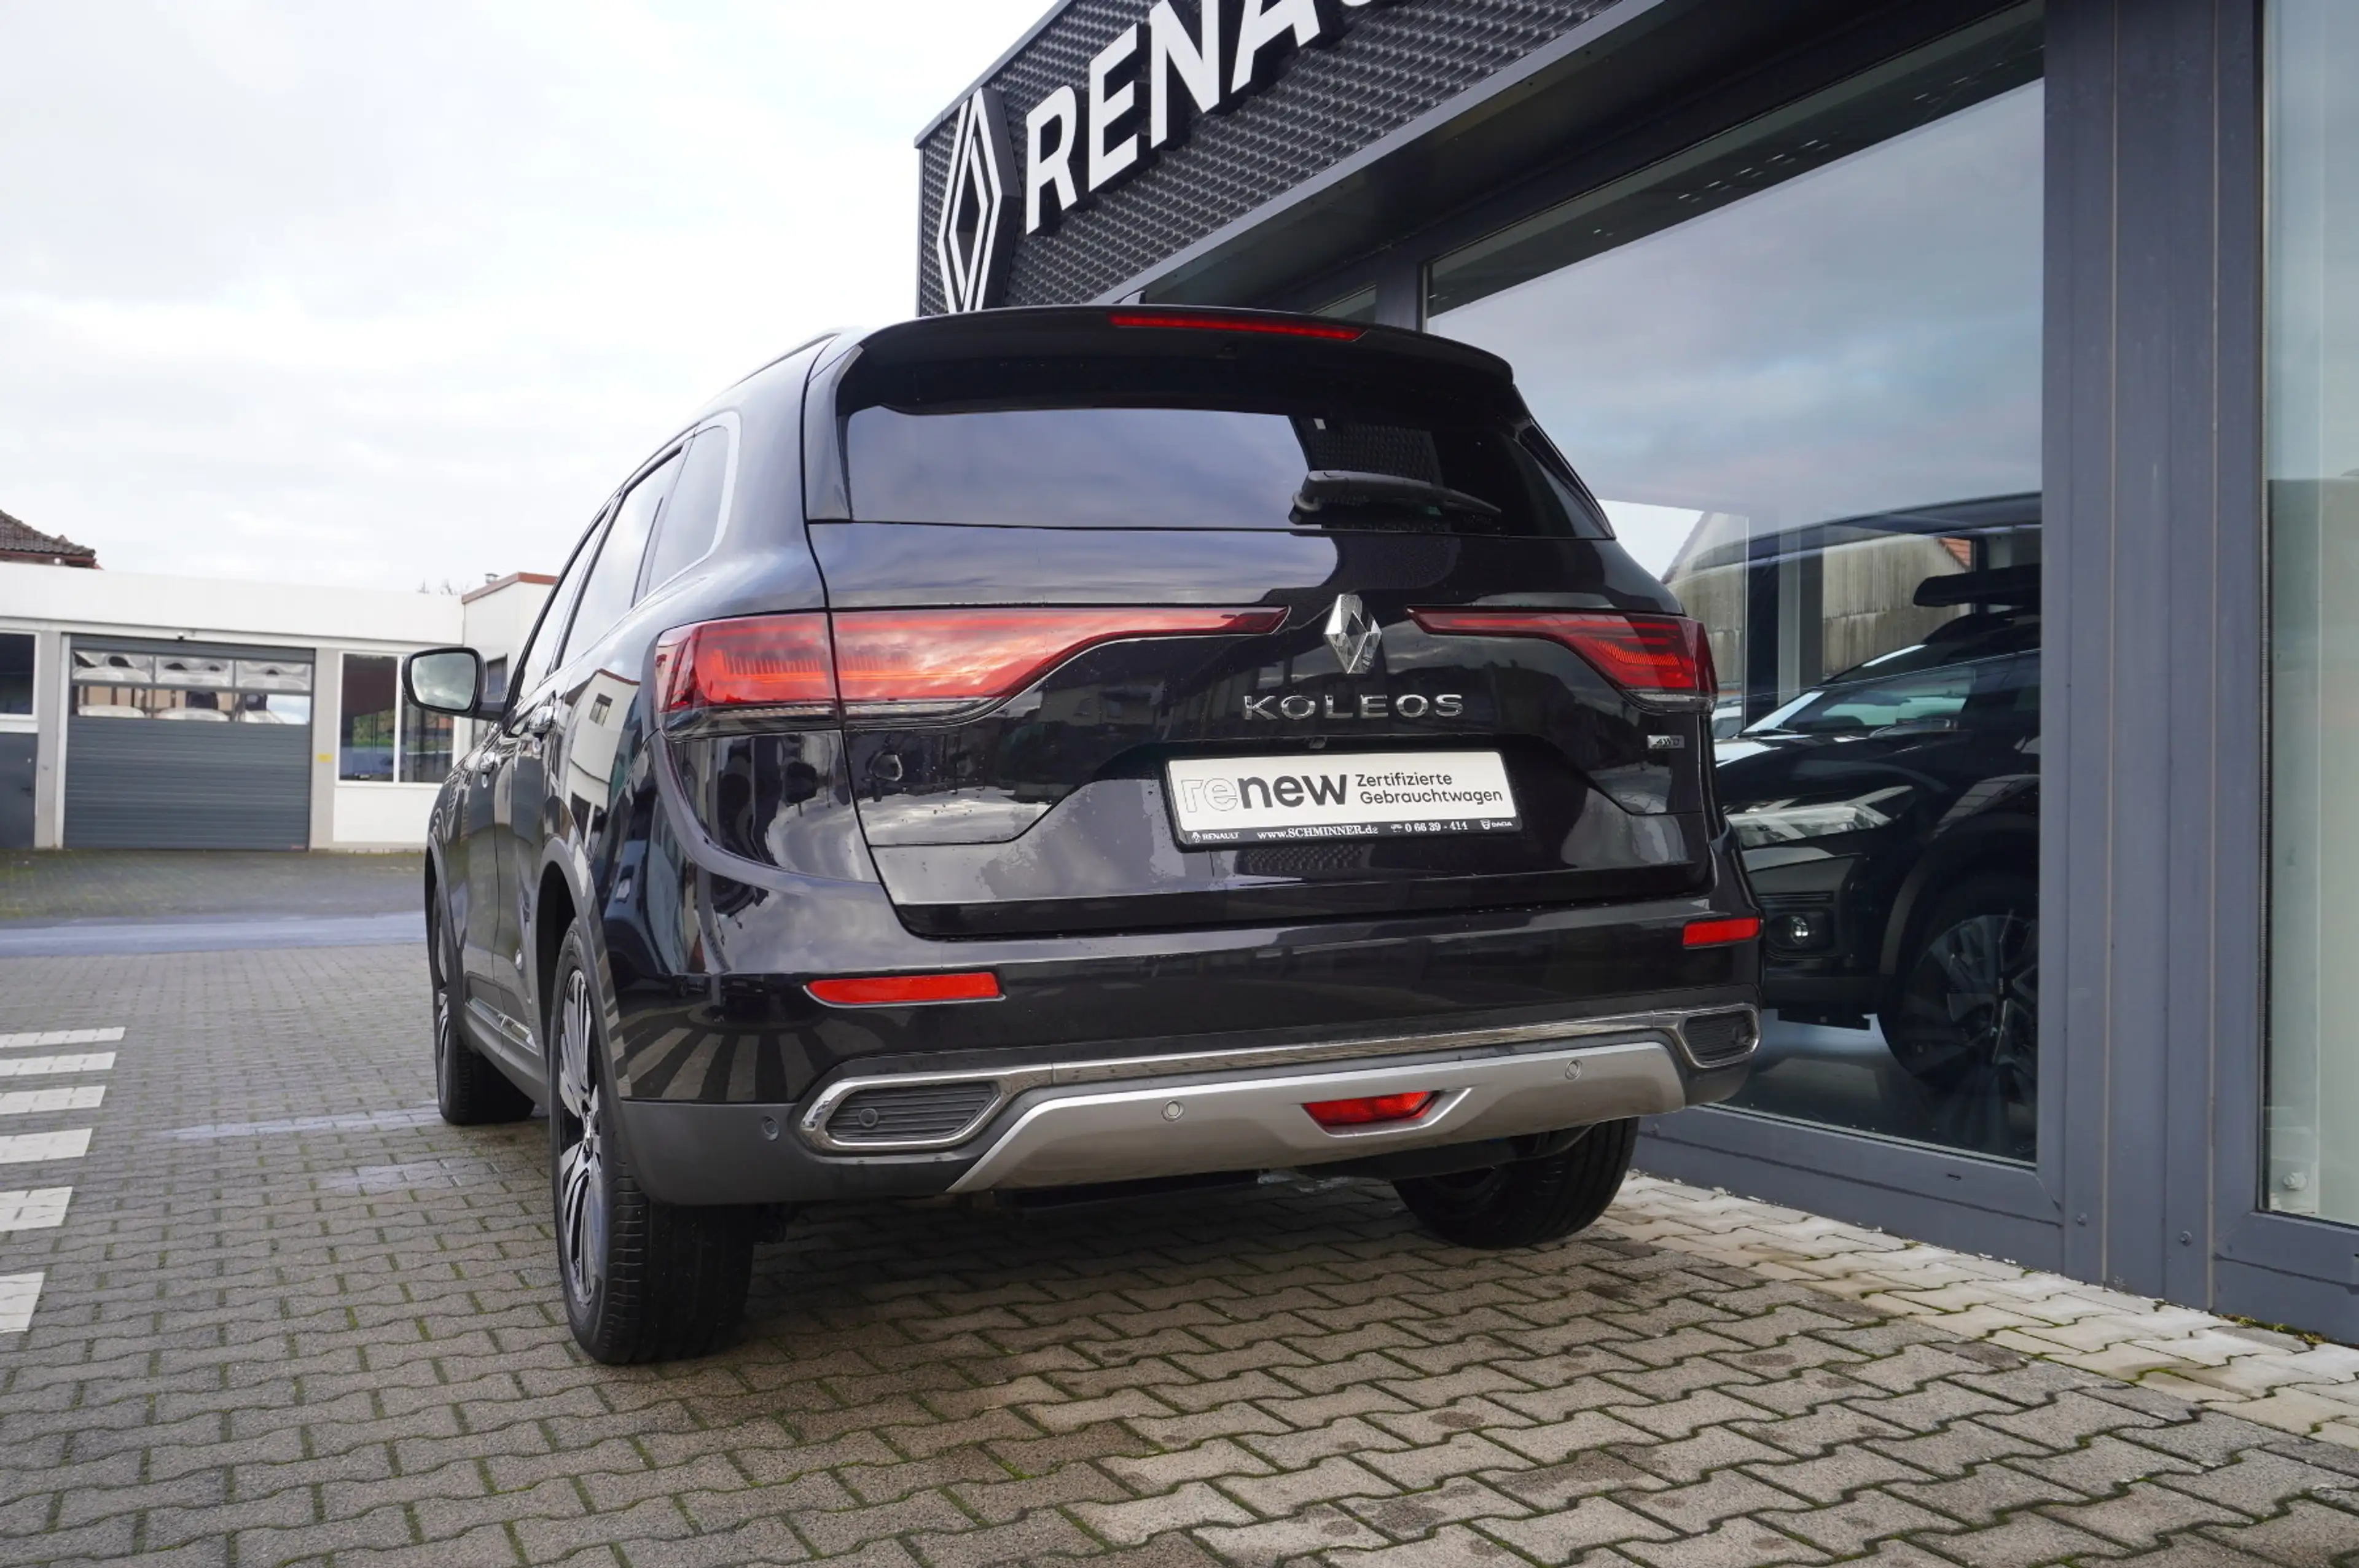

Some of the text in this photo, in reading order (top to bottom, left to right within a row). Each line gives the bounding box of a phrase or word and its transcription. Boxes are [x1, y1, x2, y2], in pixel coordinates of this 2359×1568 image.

[1027, 0, 1372, 235] RENA
[1243, 694, 1463, 720] KOLEOS
[1355, 772, 1452, 786] Zertifizierte
[1181, 774, 1347, 813] renew
[1360, 789, 1503, 805] Gebrauchtwagen
[1202, 832, 1240, 840] RENAULT
[1257, 825, 1379, 839] www.SCHMINNER.de
